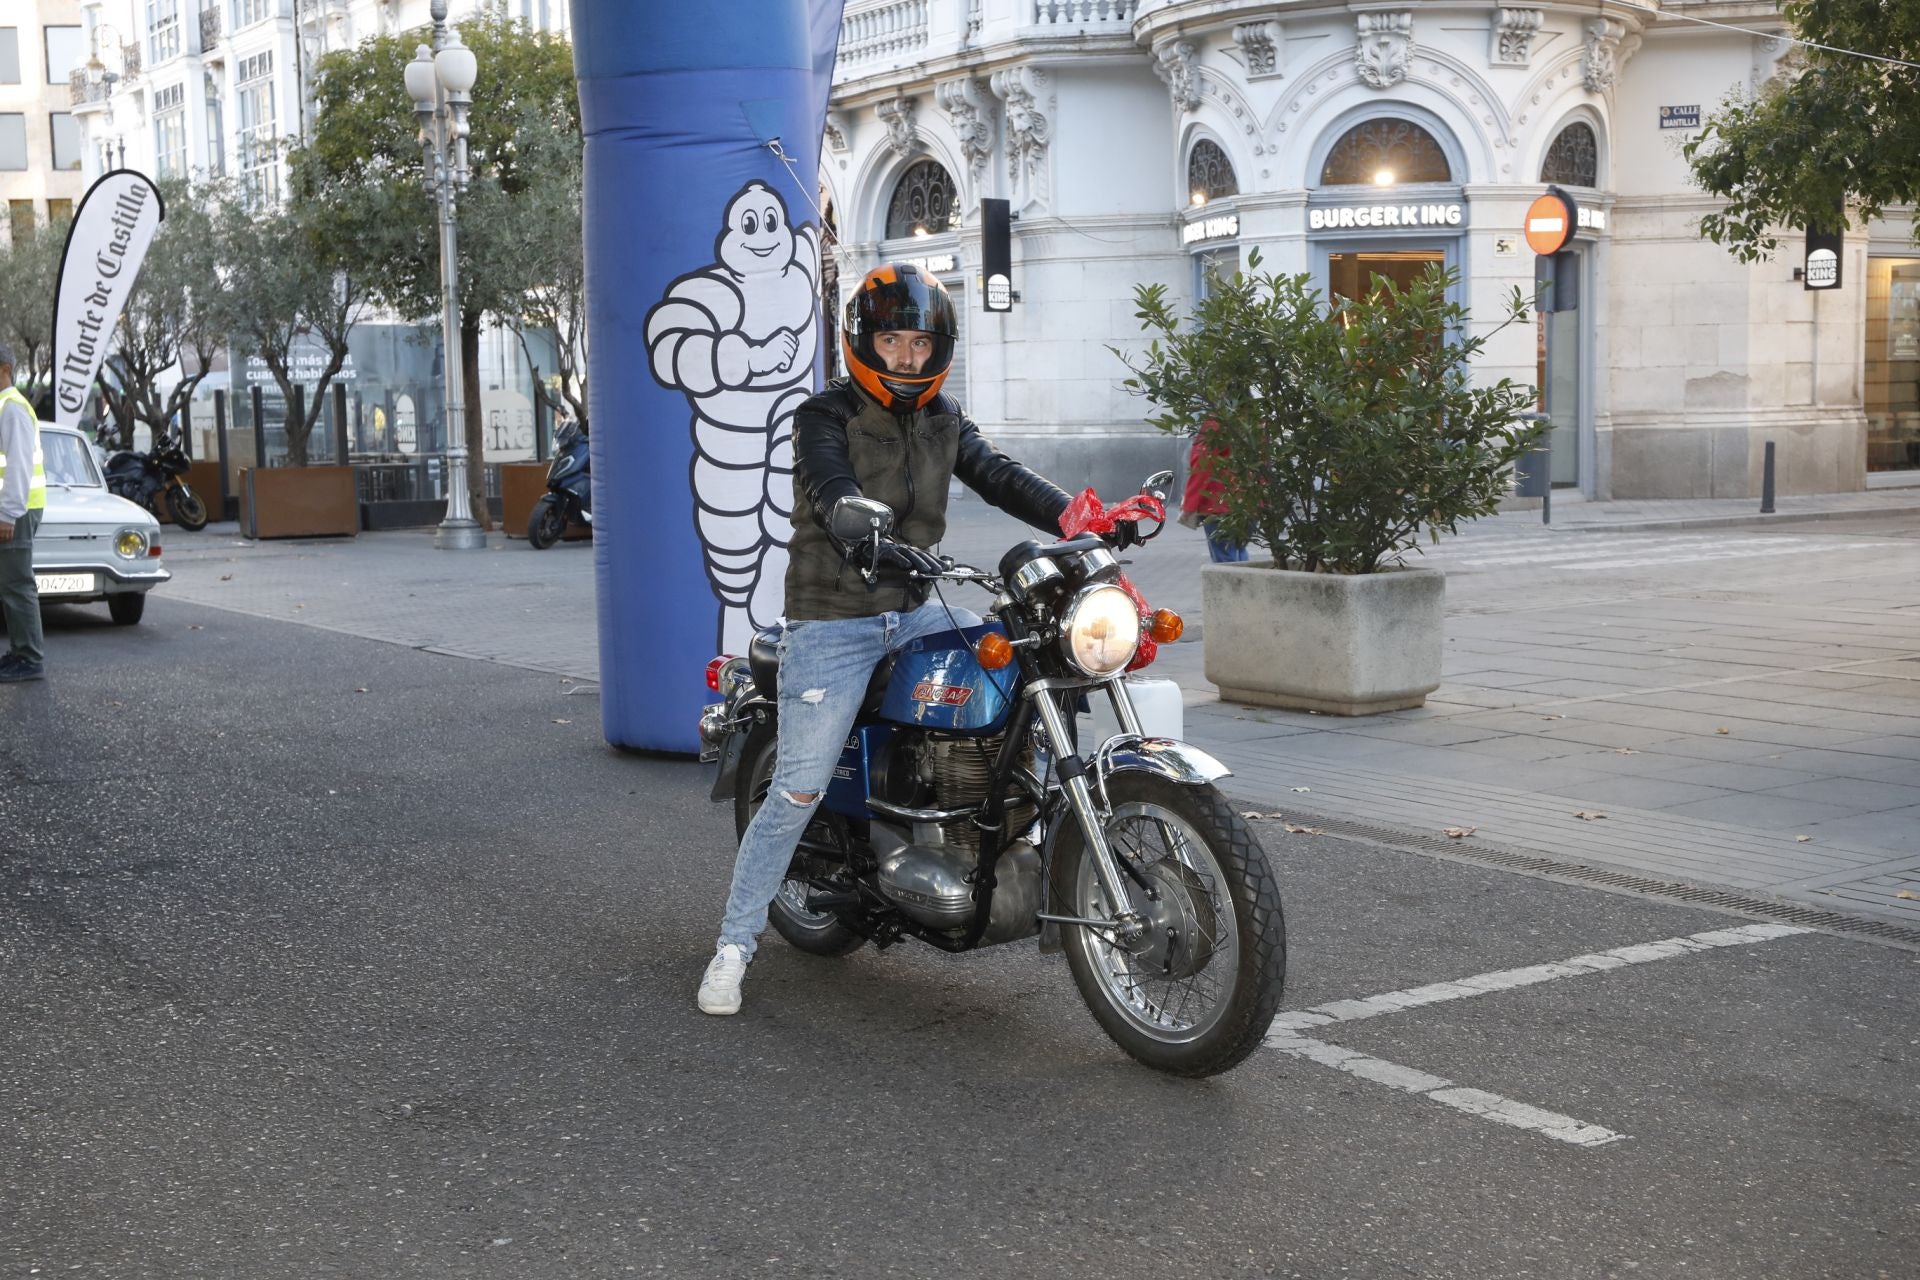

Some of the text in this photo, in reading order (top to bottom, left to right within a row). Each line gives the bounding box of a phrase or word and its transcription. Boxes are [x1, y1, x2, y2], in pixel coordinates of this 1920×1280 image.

[1673, 106, 1699, 115] CALLE
[1663, 118, 1697, 127] MANTILLA
[1309, 206, 1400, 229] BURGER
[1808, 260, 1837, 269] BURGER
[1808, 268, 1837, 280] KING
[59, 182, 149, 414] El Norte de Castilla
[988, 292, 1010, 302] KING
[296, 353, 322, 366] más
[325, 353, 353, 366] fil
[246, 367, 357, 380] cuano hablos
